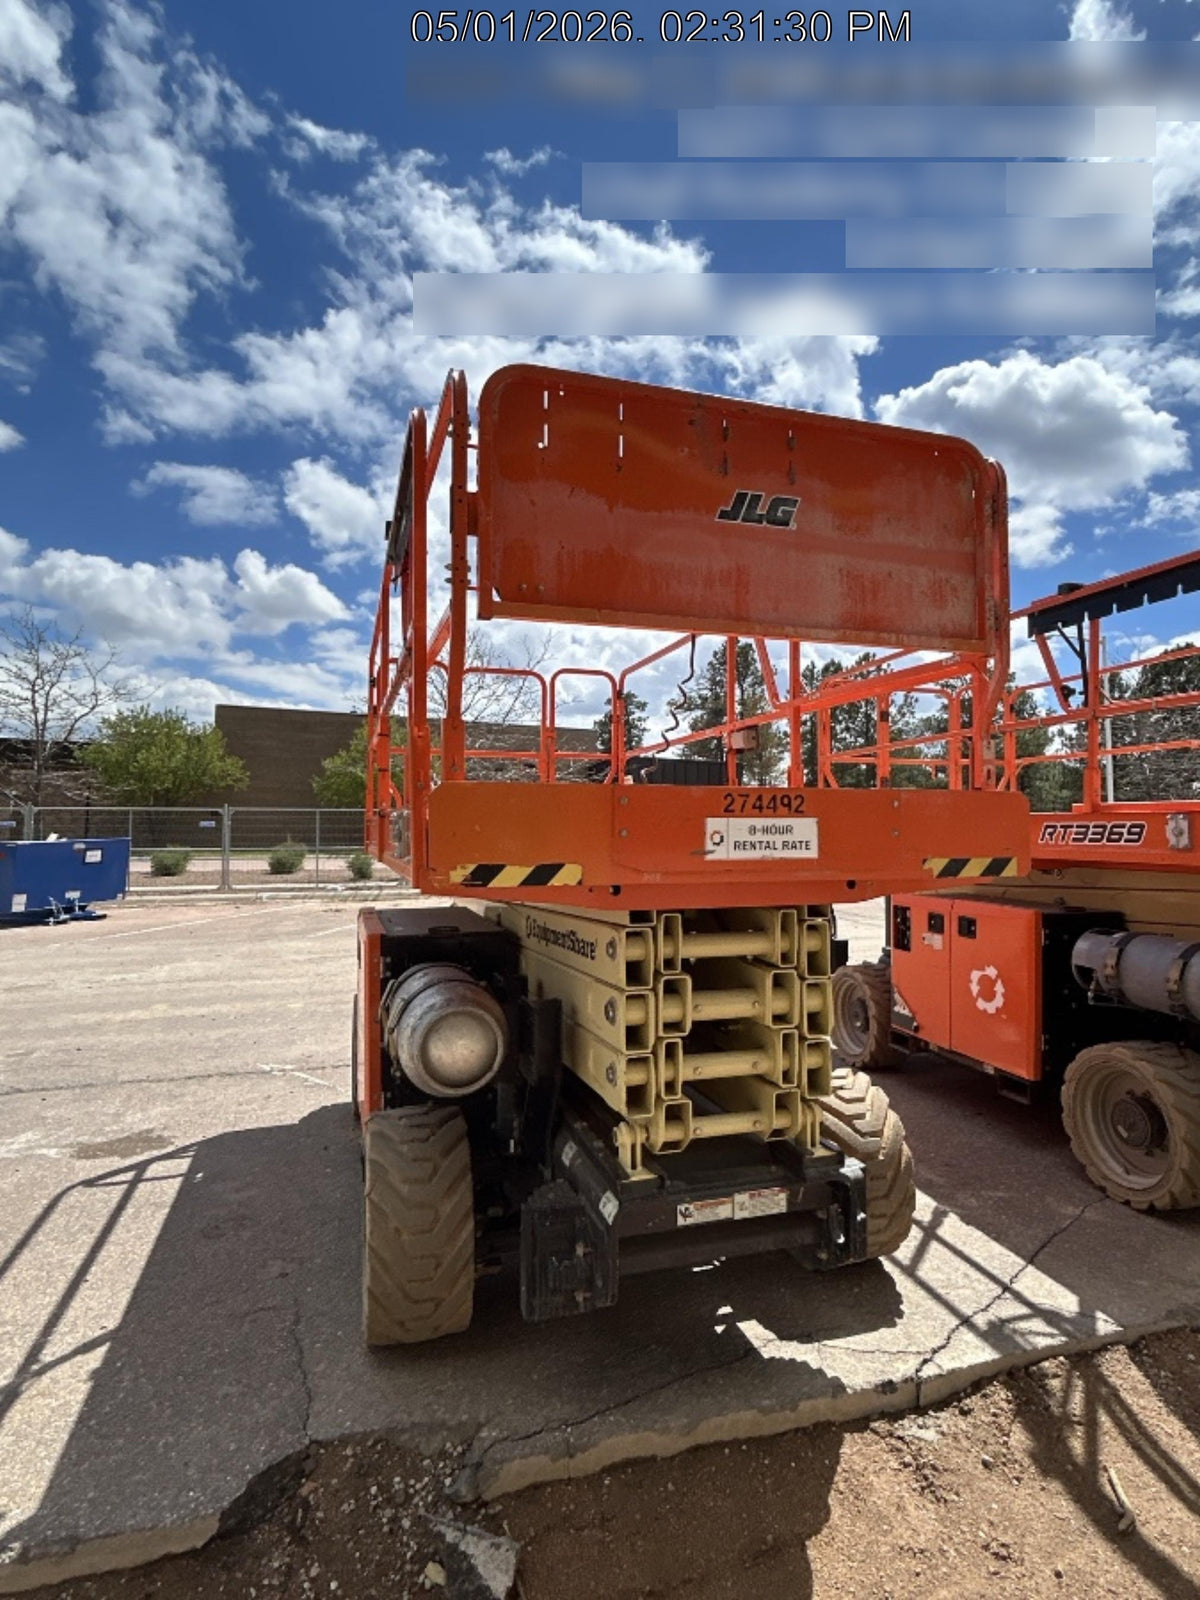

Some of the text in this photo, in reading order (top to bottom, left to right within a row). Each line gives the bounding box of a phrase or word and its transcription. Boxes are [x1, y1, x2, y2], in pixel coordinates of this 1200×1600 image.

[714, 489, 801, 529] JLG
[723, 793, 805, 813] 274492
[1038, 822, 1147, 846] RT3369
[733, 840, 811, 851] RENTAL RATE
